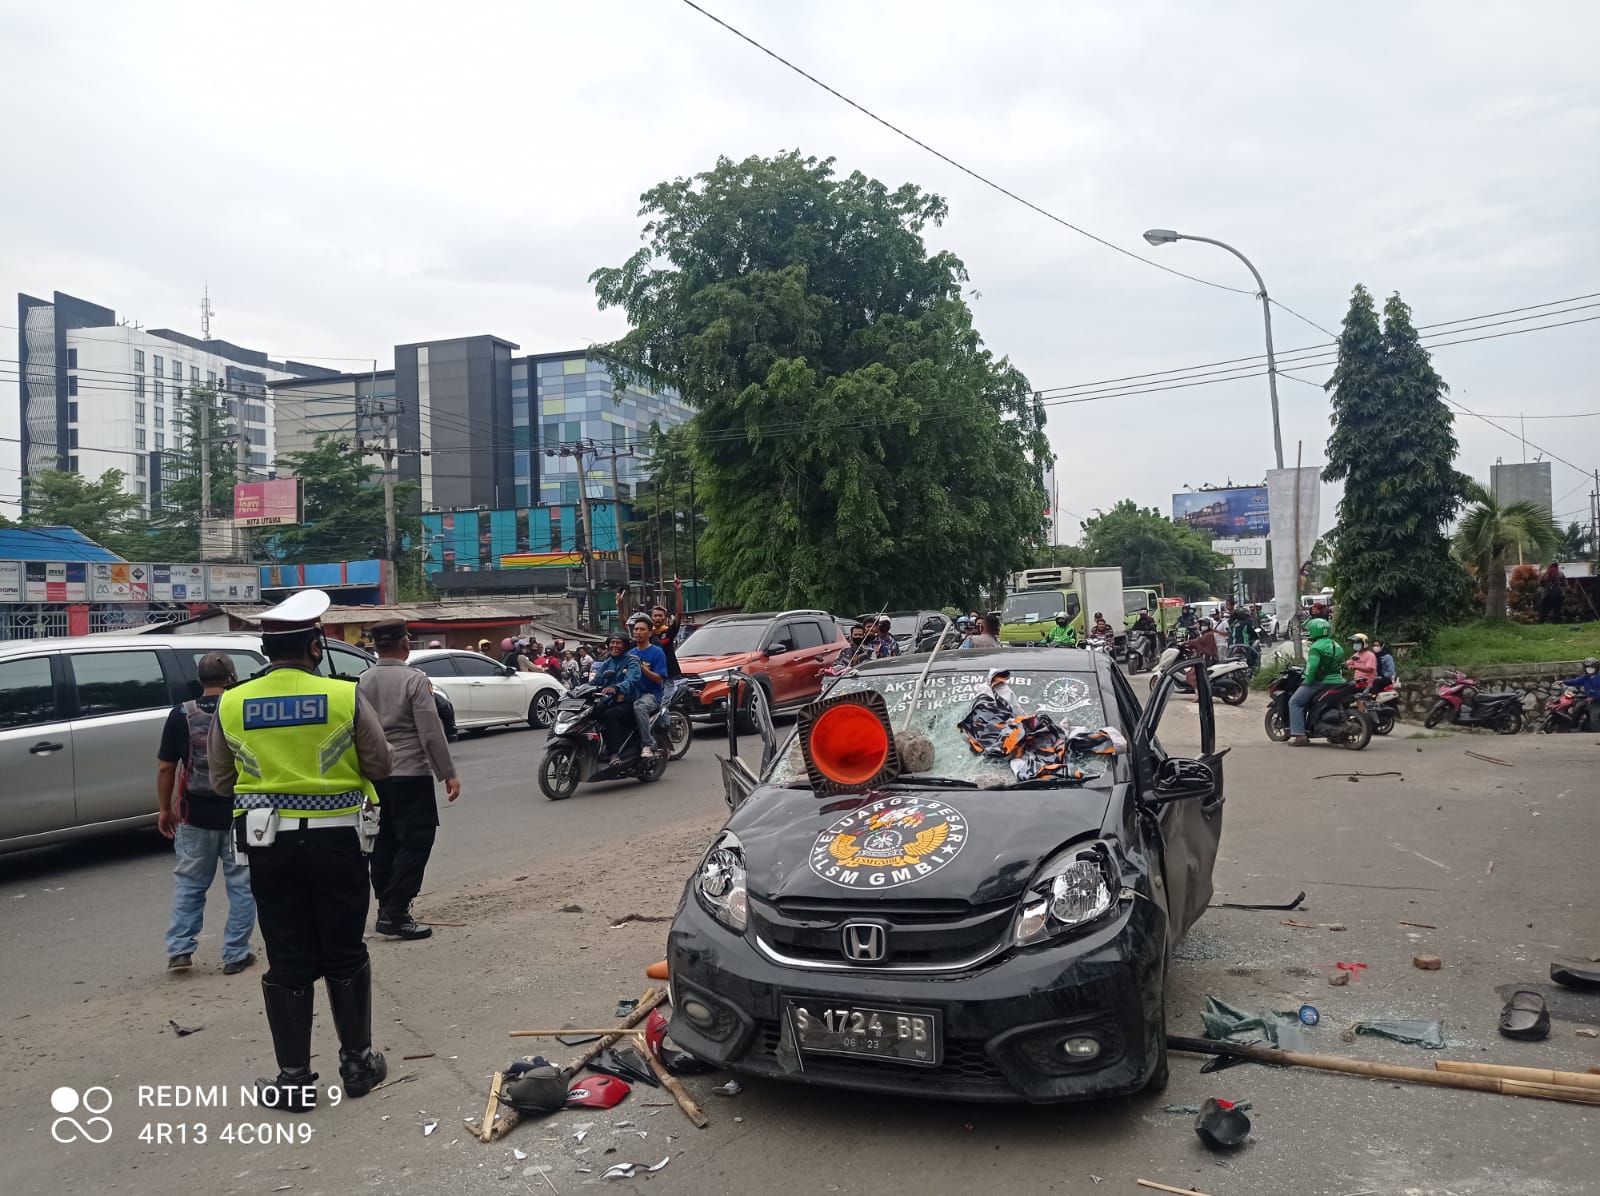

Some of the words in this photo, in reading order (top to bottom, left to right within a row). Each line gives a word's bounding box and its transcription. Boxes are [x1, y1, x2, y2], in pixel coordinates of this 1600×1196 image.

[262, 516, 282, 525] UTAMA
[951, 674, 984, 686] LSM
[245, 699, 325, 723] POLISI
[926, 802, 965, 845] BESAR
[815, 858, 860, 885] LSM
[869, 855, 945, 886] GMBI
[823, 1009, 884, 1037] 1724
[897, 1016, 927, 1042] BB
[843, 1037, 856, 1048] 06
[867, 1038, 880, 1049] 23
